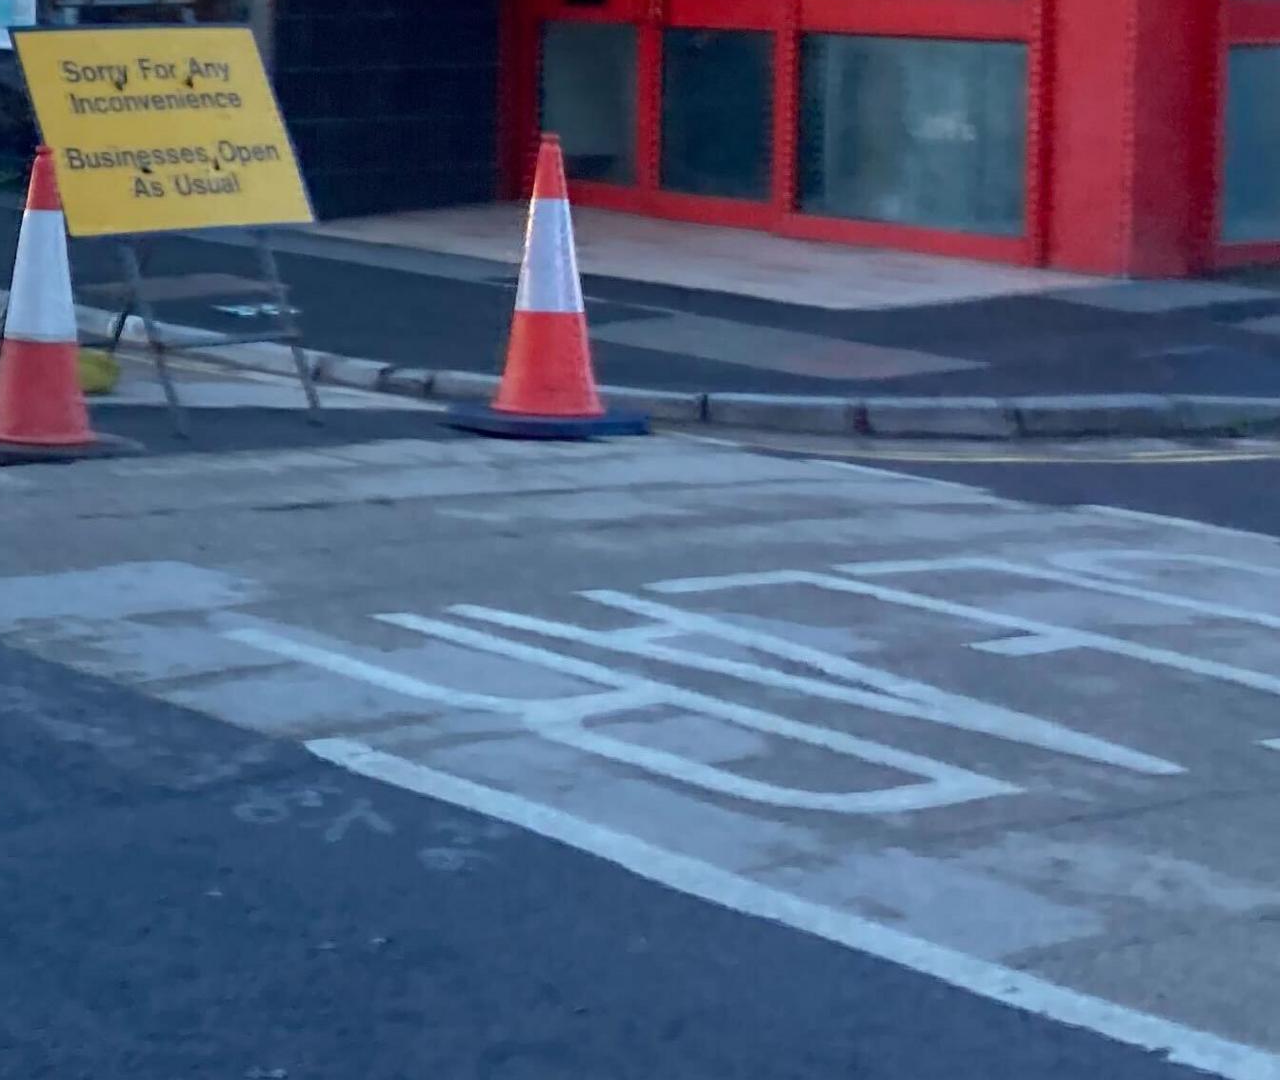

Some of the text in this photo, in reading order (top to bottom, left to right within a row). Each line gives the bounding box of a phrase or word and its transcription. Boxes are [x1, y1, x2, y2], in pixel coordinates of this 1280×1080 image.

[62, 57, 230, 88] Sorry For Any
[70, 91, 242, 115] Inconvenience
[218, 140, 280, 168] Open
[133, 172, 240, 199] As Usual
